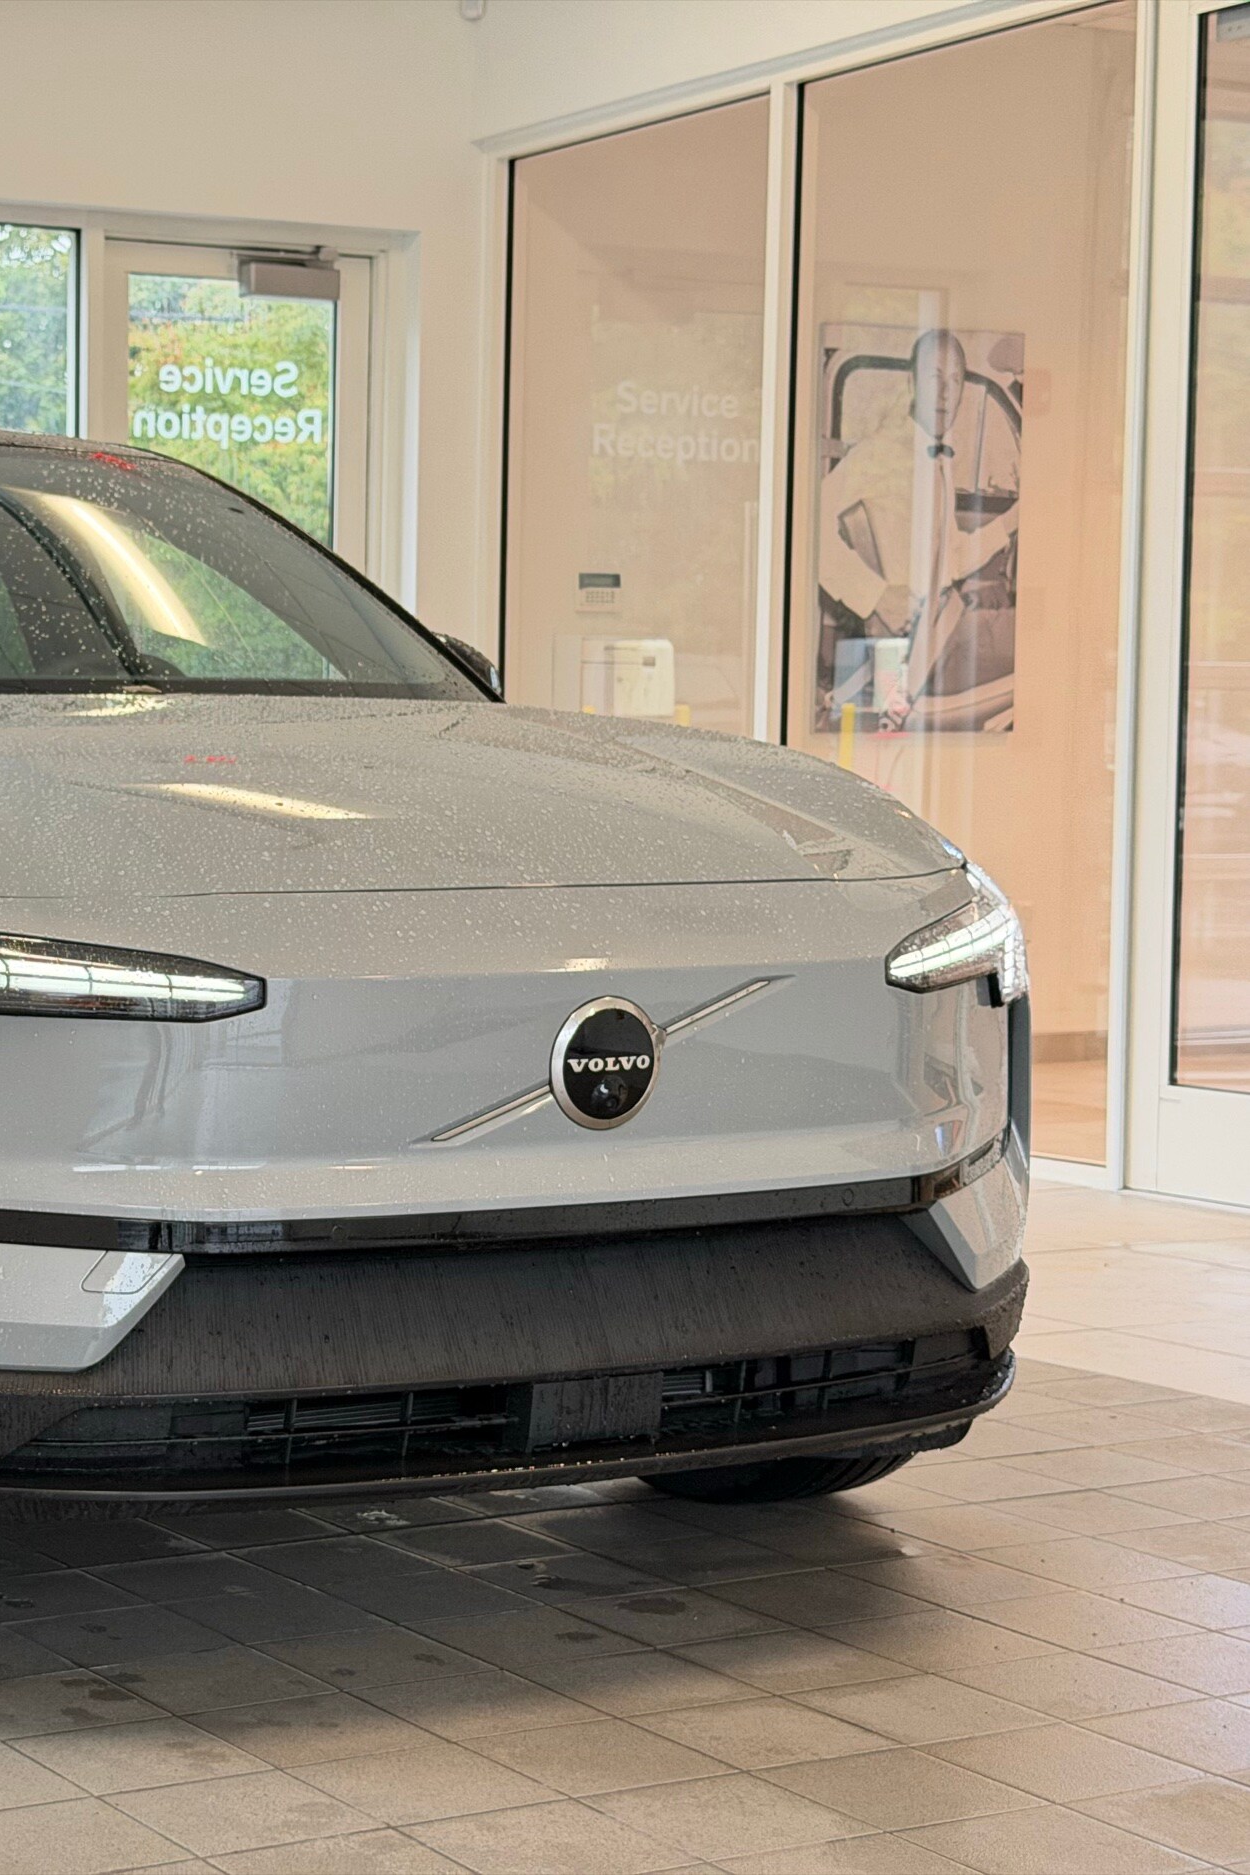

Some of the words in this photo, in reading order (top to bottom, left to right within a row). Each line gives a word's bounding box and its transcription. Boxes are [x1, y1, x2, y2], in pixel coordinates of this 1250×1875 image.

[616, 380, 739, 420] Service
[591, 422, 762, 468] Reception
[567, 1054, 651, 1073] VOLVO
